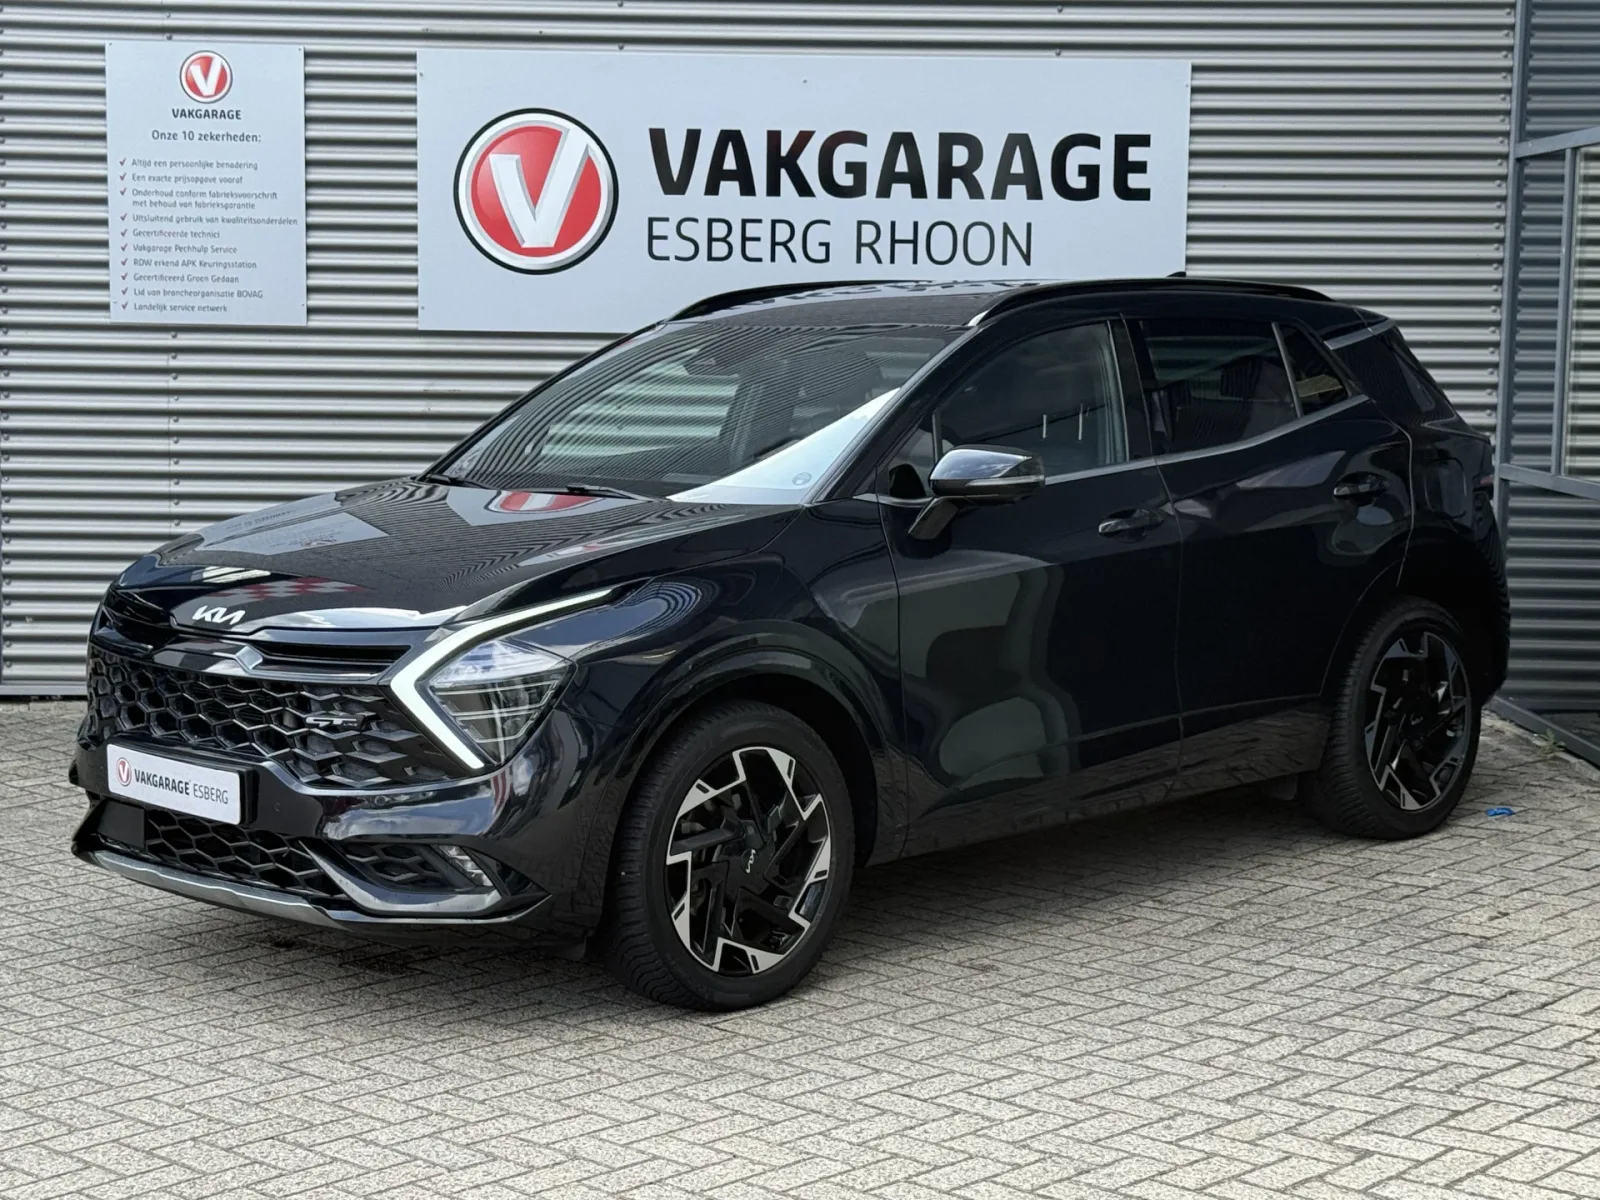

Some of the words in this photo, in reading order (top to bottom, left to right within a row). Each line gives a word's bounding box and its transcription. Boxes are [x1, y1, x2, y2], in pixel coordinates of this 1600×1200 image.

[172, 108, 242, 120] VAKGARAGE
[152, 130, 178, 141] Onze
[182, 131, 194, 141] 10
[198, 131, 262, 143] zekerheden:
[132, 159, 151, 168] Altijd
[170, 160, 214, 169] persoonlijke
[216, 161, 258, 170] benadering
[649, 128, 1152, 202] VAKGARAGE
[132, 173, 146, 181] Een
[175, 176, 216, 184] prijsopgave
[219, 176, 243, 184] vooraf
[132, 189, 173, 198] Onderhoud
[176, 190, 206, 198] conform
[209, 190, 278, 199] fabrieksvoorschrift
[150, 200, 177, 208] behoud
[195, 201, 255, 210] fabrieksgarantie
[133, 214, 173, 223] Uitsluitend
[176, 215, 203, 224] gebruik
[221, 216, 298, 225] kwaliteitsonderdelen
[133, 229, 188, 238] Gecertificeerde
[647, 217, 831, 264] ESBERG
[855, 219, 1033, 267] RHOON
[133, 244, 172, 253] Vakgarage
[175, 245, 208, 254] Pechhulp
[133, 259, 152, 267] RDW
[154, 259, 179, 267] erkend
[200, 260, 257, 269] Keuringsstation
[133, 274, 184, 282] Gecertificeerd
[211, 275, 239, 283] Gedaan
[134, 288, 145, 296] Lid
[163, 289, 234, 299] brancheorganisatie
[237, 290, 263, 298] BOVAG
[134, 303, 168, 312] Landelijk
[170, 304, 195, 312] service
[198, 304, 227, 312] netwerk
[134, 770, 190, 795] VAKGARAGE
[193, 786, 228, 804] ESBERG
